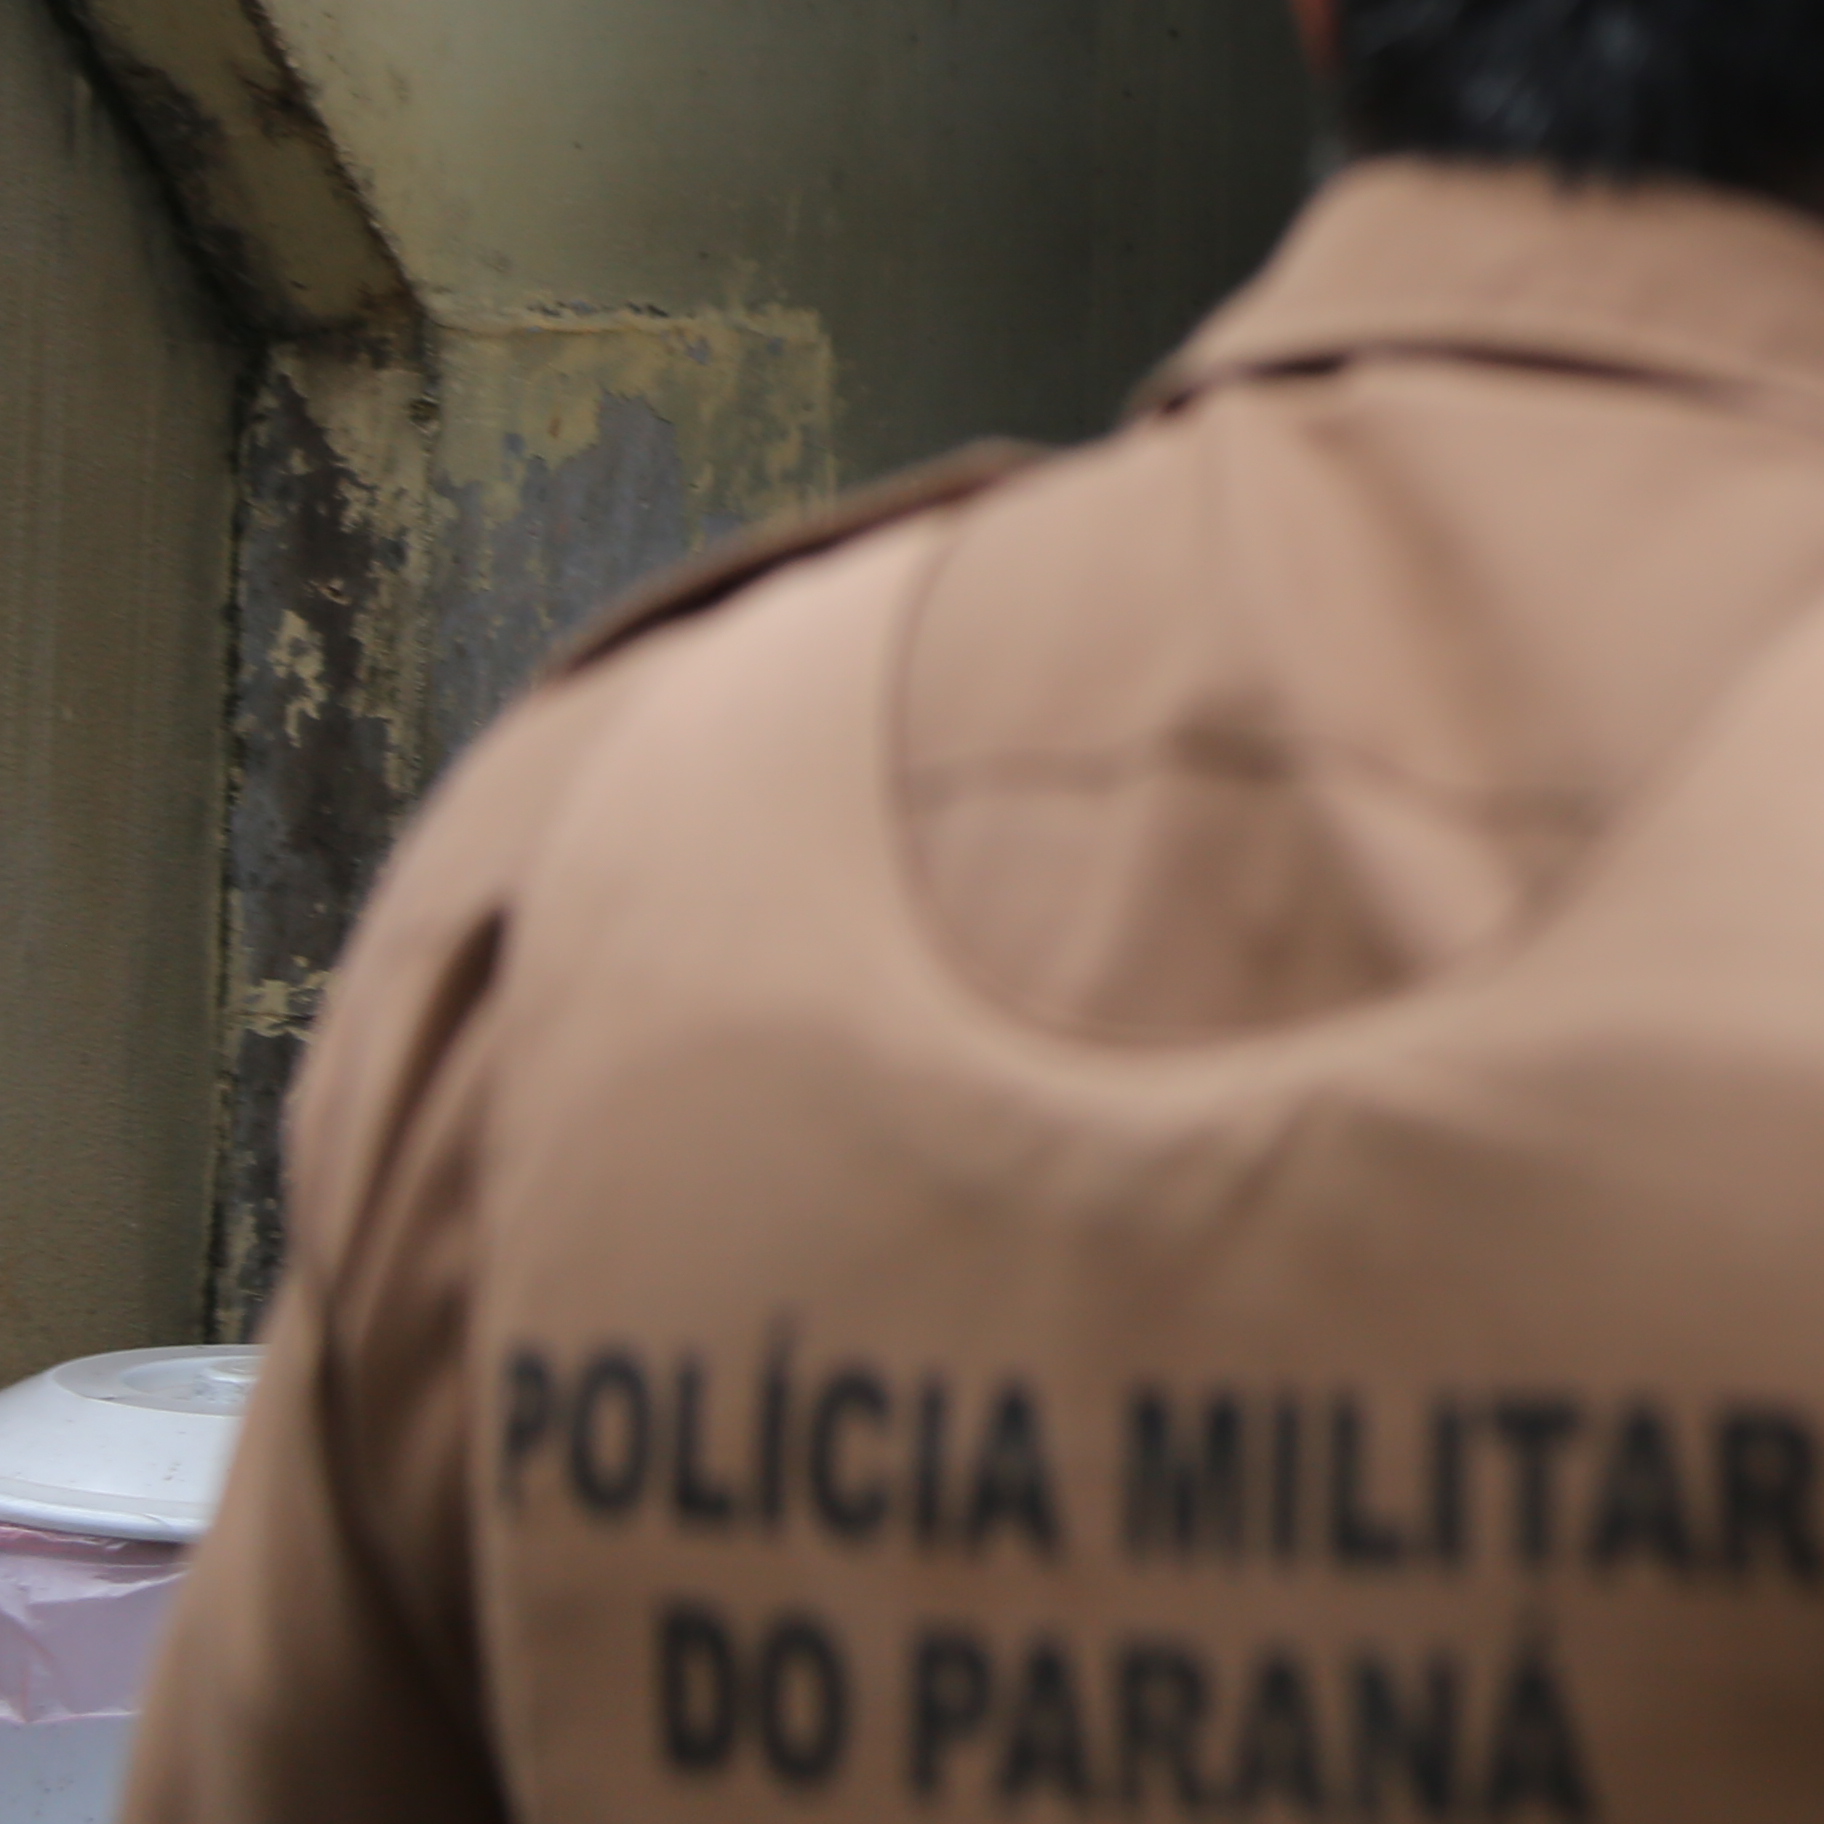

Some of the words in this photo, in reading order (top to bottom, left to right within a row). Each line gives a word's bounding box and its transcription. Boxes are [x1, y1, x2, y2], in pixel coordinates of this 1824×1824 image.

[502, 1307, 1059, 1555] POLÍCIA
[656, 1600, 848, 1791] DO
[908, 1607, 1598, 1823] PARANÁ
